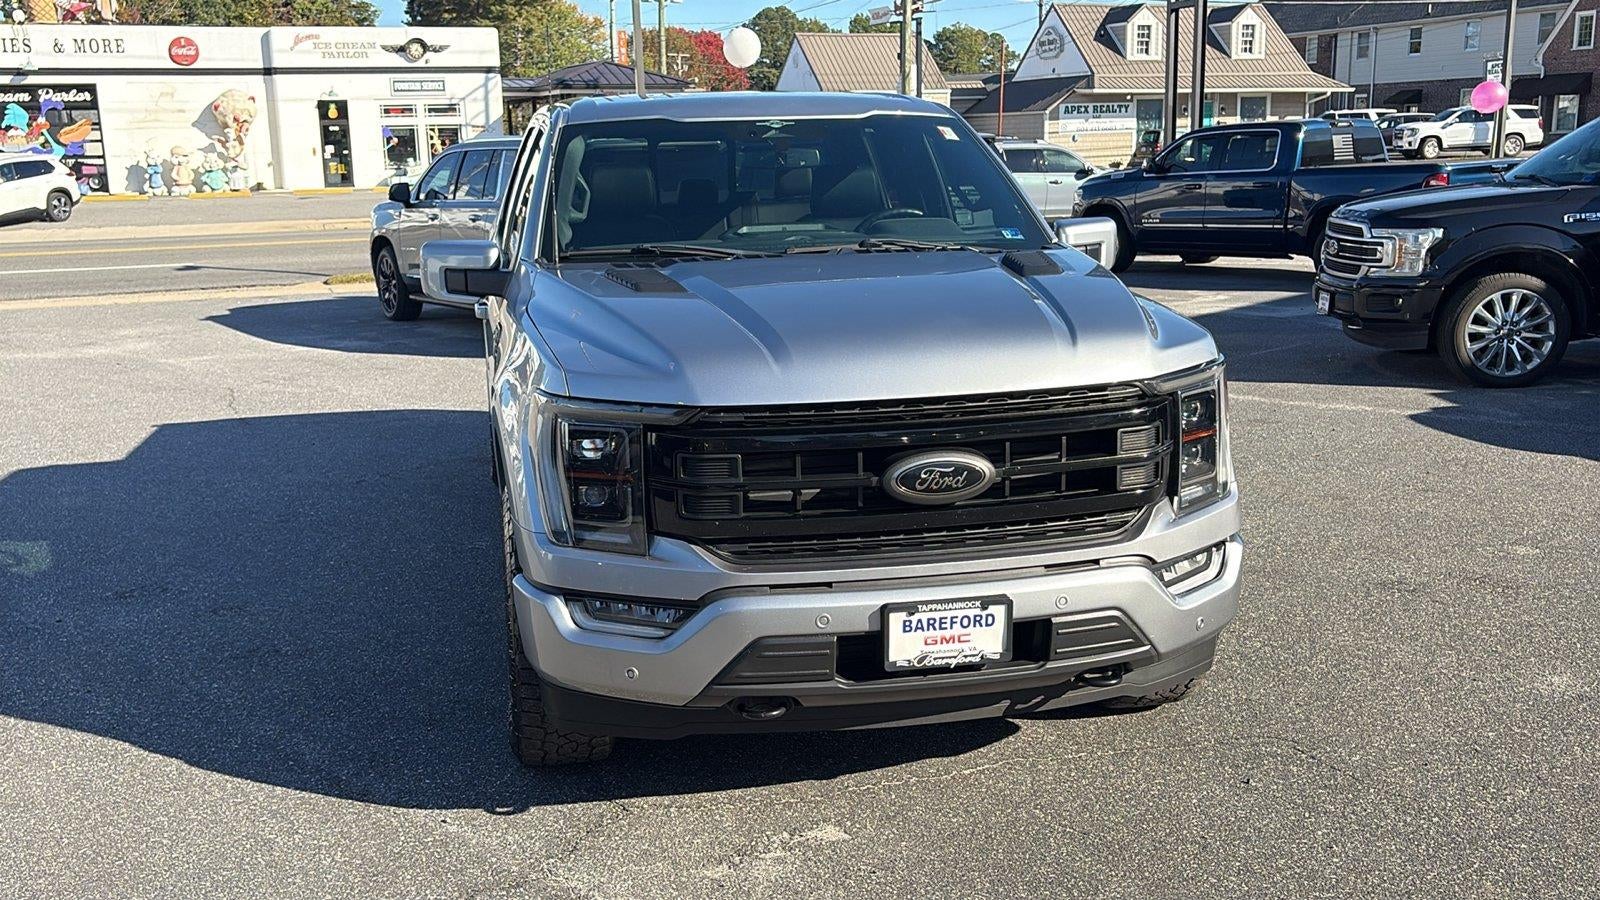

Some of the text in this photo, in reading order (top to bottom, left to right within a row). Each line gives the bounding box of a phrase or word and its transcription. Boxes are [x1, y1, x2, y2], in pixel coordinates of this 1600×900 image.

[53, 38, 65, 53] &
[73, 38, 125, 53] MORE
[312, 41, 332, 50] ICE
[334, 41, 377, 50] CREAM
[321, 51, 369, 59] PARLOR
[38, 88, 93, 102] Parlor
[1063, 104, 1130, 115] APEX REALTY
[915, 466, 968, 491] Ford
[917, 600, 982, 612] TAPPAHANNOCK
[902, 613, 995, 633] BAREFORD
[924, 633, 971, 646] GMC
[913, 650, 985, 669] Bareford
